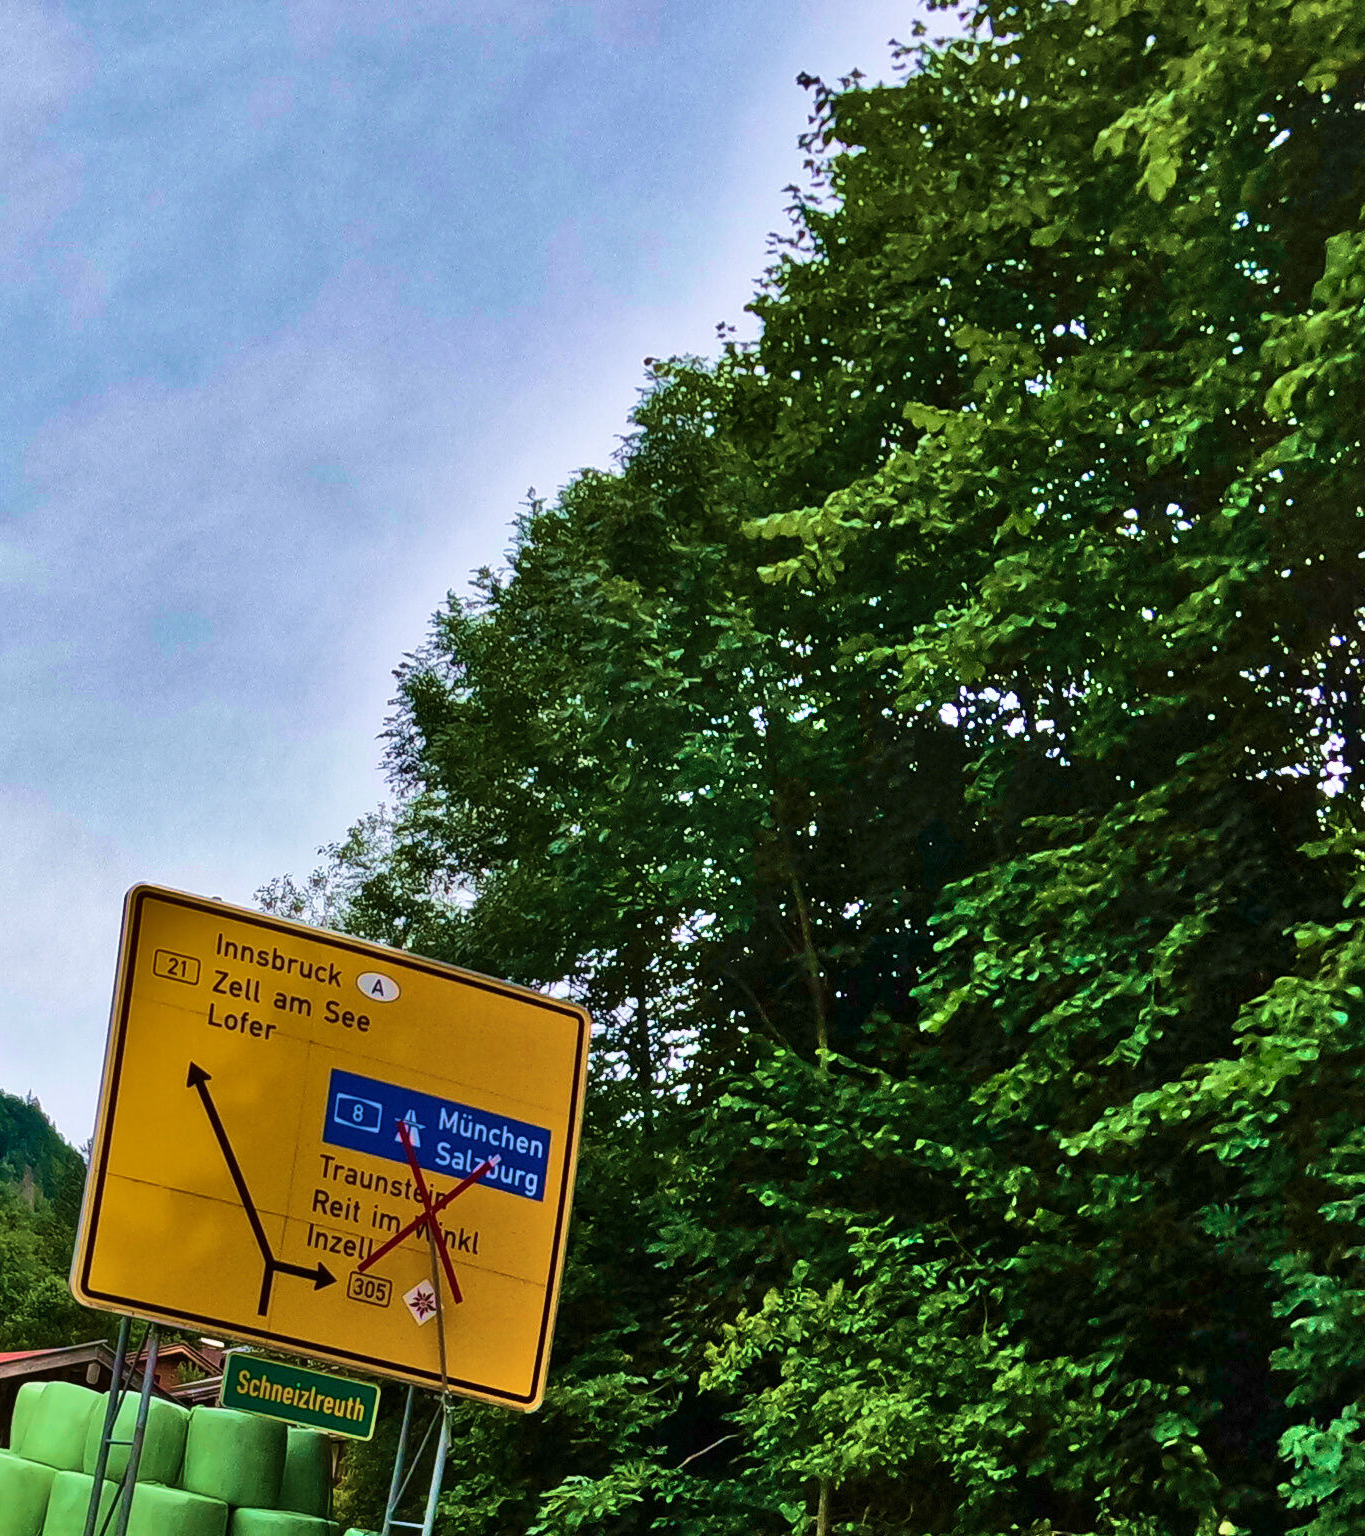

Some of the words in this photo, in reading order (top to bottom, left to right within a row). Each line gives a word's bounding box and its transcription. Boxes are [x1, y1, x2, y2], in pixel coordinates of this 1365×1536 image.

[167, 957, 187, 978] 21
[216, 933, 342, 988] Innsbruck
[212, 969, 261, 1003] Zell
[273, 991, 312, 1017] am
[323, 1000, 371, 1032] See
[371, 978, 385, 997] A
[207, 1003, 277, 1040] Lofer
[352, 1103, 364, 1122] 8
[438, 1107, 543, 1158] München
[312, 1189, 361, 1223] Reit
[371, 1205, 401, 1234] im
[307, 1223, 373, 1260] Inzell
[353, 1278, 387, 1301] 305
[236, 1370, 365, 1422] Schneizlreuth
